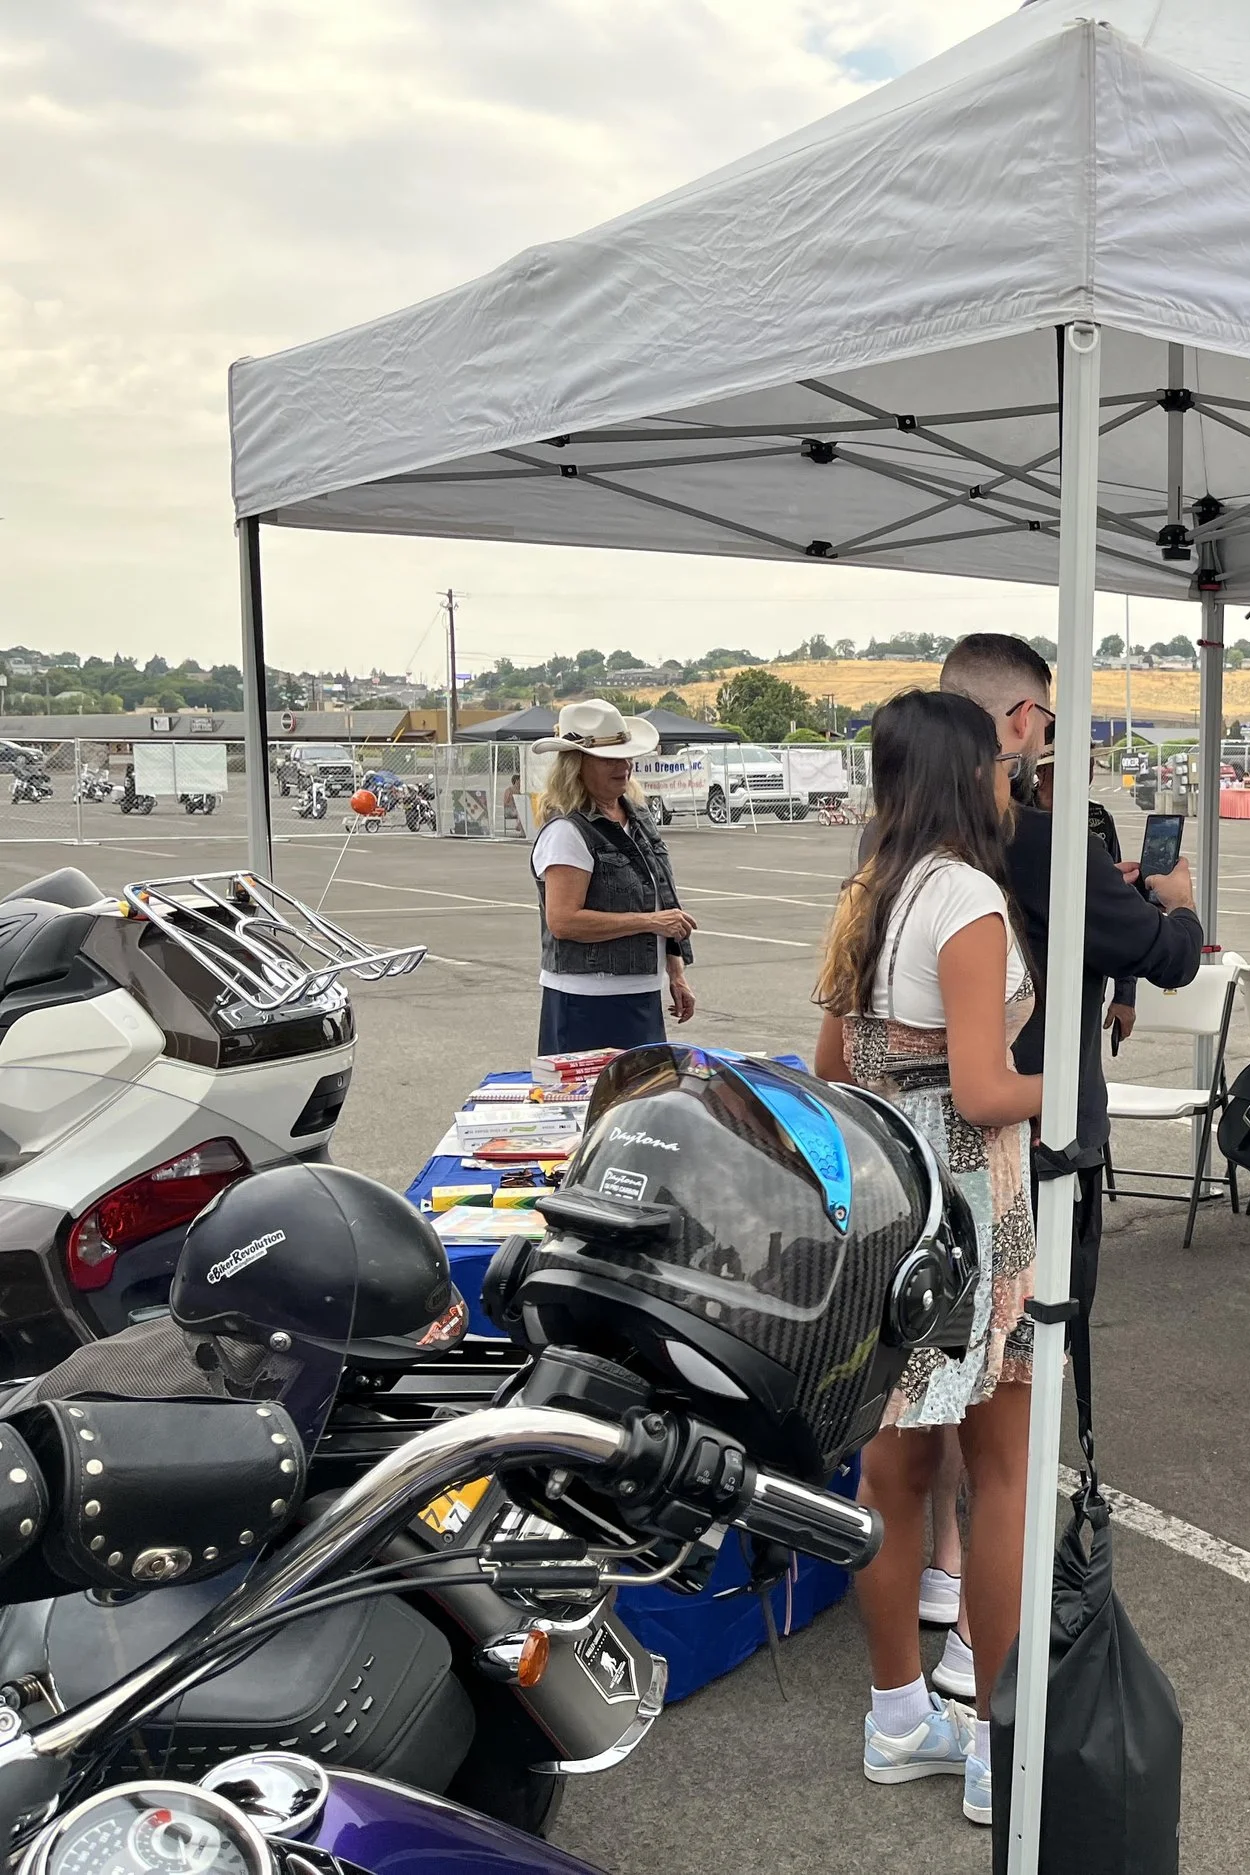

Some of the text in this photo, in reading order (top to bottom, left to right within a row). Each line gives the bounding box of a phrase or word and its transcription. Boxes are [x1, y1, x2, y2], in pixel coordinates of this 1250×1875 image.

[608, 1126, 680, 1152] Daytona
[606, 1171, 642, 1187] Daytona
[208, 1231, 284, 1281] #BikerRevolution
